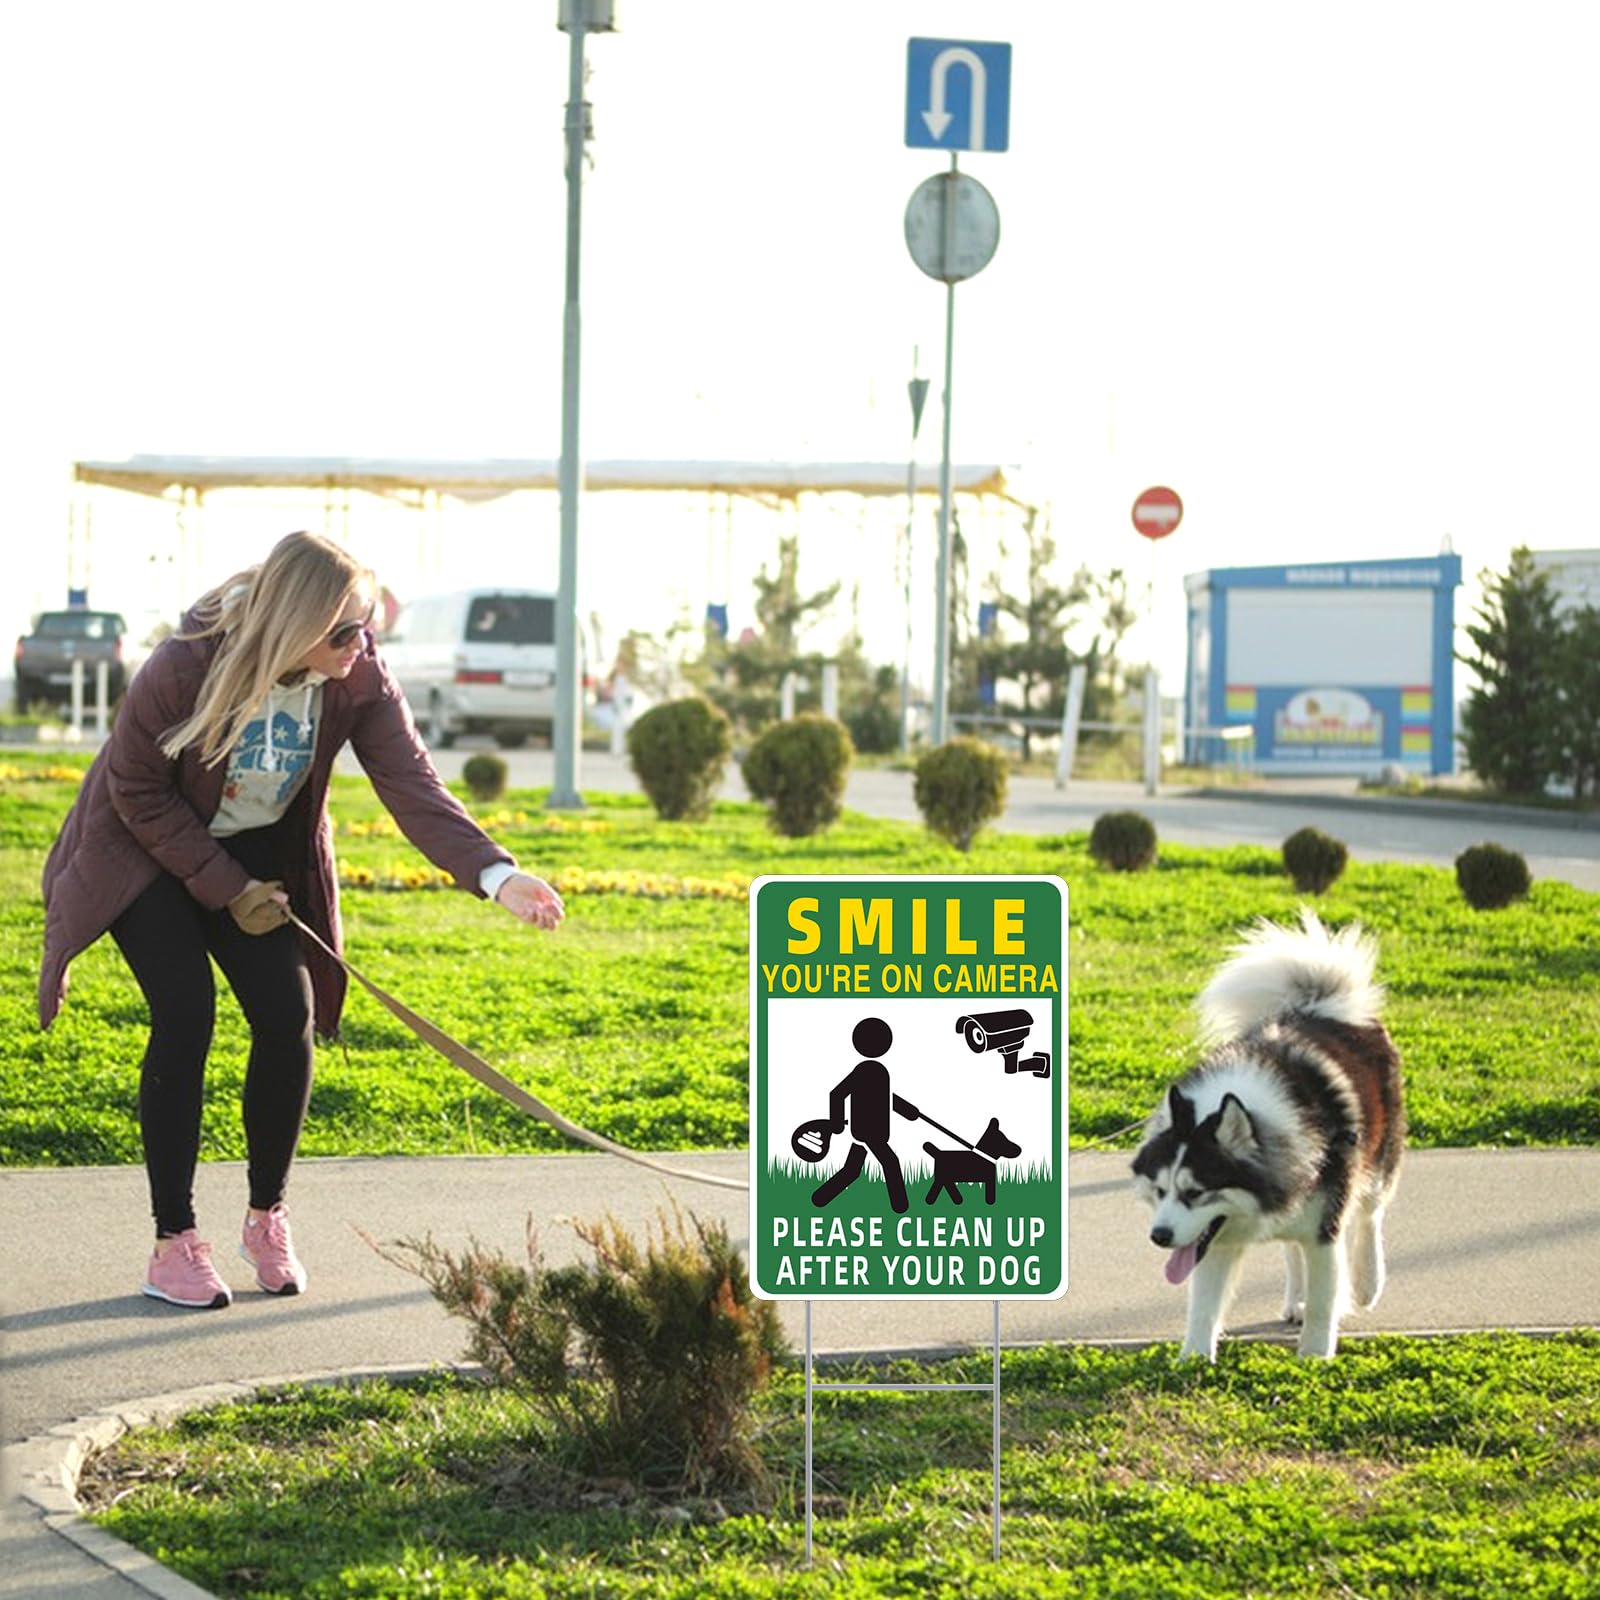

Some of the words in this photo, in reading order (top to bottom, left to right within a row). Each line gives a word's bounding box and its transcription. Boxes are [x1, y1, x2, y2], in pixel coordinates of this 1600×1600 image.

[787, 897, 1026, 955] SMILE
[762, 963, 871, 993] YOU'RE
[881, 963, 923, 993] ON
[933, 963, 1059, 993] CAMERA
[773, 1216, 883, 1247] PLEASE
[896, 1216, 992, 1247] CLEAN
[1007, 1216, 1046, 1247] UP
[775, 1255, 870, 1286] AFTER
[881, 1255, 965, 1286] YOUR
[978, 1255, 1041, 1286] DOG
